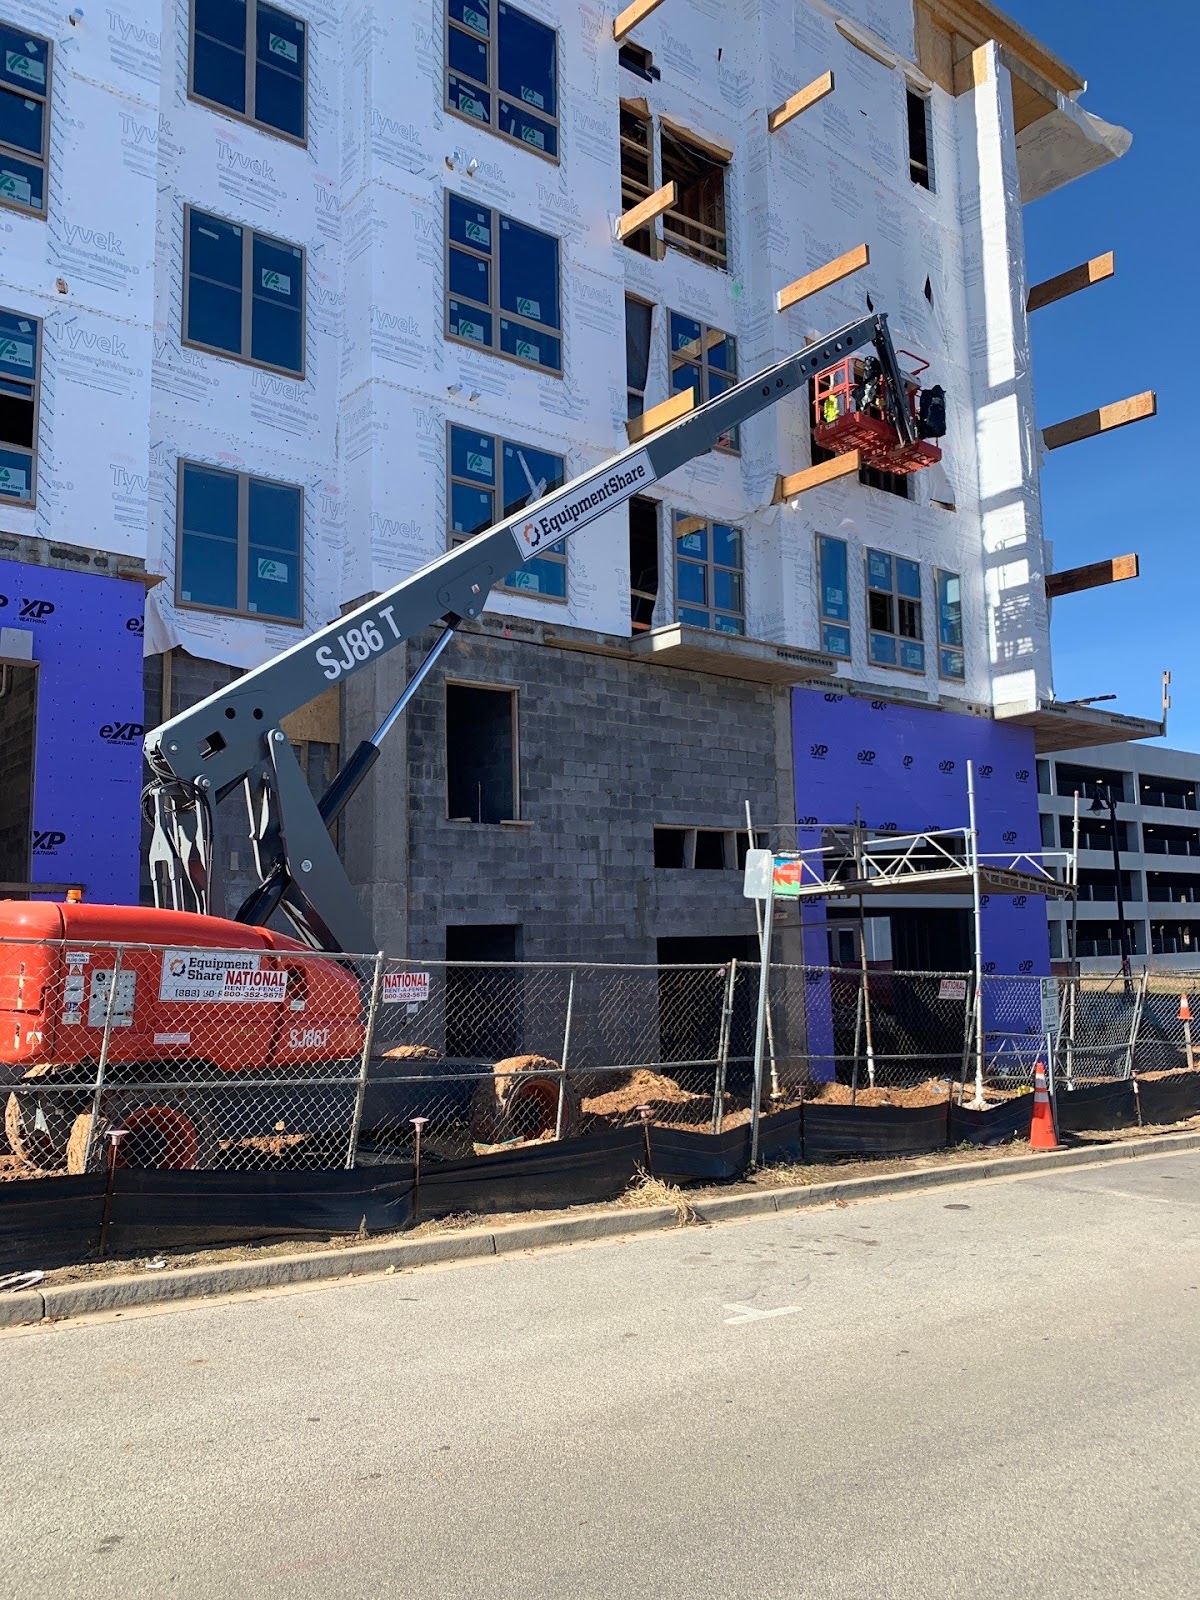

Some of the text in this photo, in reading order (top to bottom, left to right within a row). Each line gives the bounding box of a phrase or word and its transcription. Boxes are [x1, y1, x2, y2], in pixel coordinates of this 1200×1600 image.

[106, 9, 161, 49] Tyve
[119, 111, 158, 143] Tyv
[372, 108, 422, 146] Tyvek
[570, 104, 613, 140] Tyvek
[215, 138, 276, 182] Tyvek
[536, 183, 581, 217] Tyvek
[62, 217, 125, 256] yvek
[570, 276, 613, 307] Tyvek
[368, 305, 421, 337] Tyvek
[251, 371, 308, 405] Tyvek
[538, 464, 646, 537] EquipmentShare
[369, 512, 424, 541] Tyvek
[19, 598, 55, 619] XP
[315, 619, 384, 679] SJ86
[378, 605, 402, 639] T
[99, 722, 144, 740] eXP
[857, 750, 876, 762] eXP
[939, 760, 955, 772] eXP
[1015, 770, 1030, 781] eXP
[32, 830, 66, 850] XP
[1002, 831, 1017, 842] eXP
[1012, 896, 1027, 906] eXP
[189, 957, 254, 971] Equipment
[1019, 960, 1034, 972] eXP
[187, 969, 223, 981] Share
[225, 970, 285, 987] NATIONAL
[384, 974, 428, 988] NATIONAL
[941, 980, 965, 990] NATIONAL
